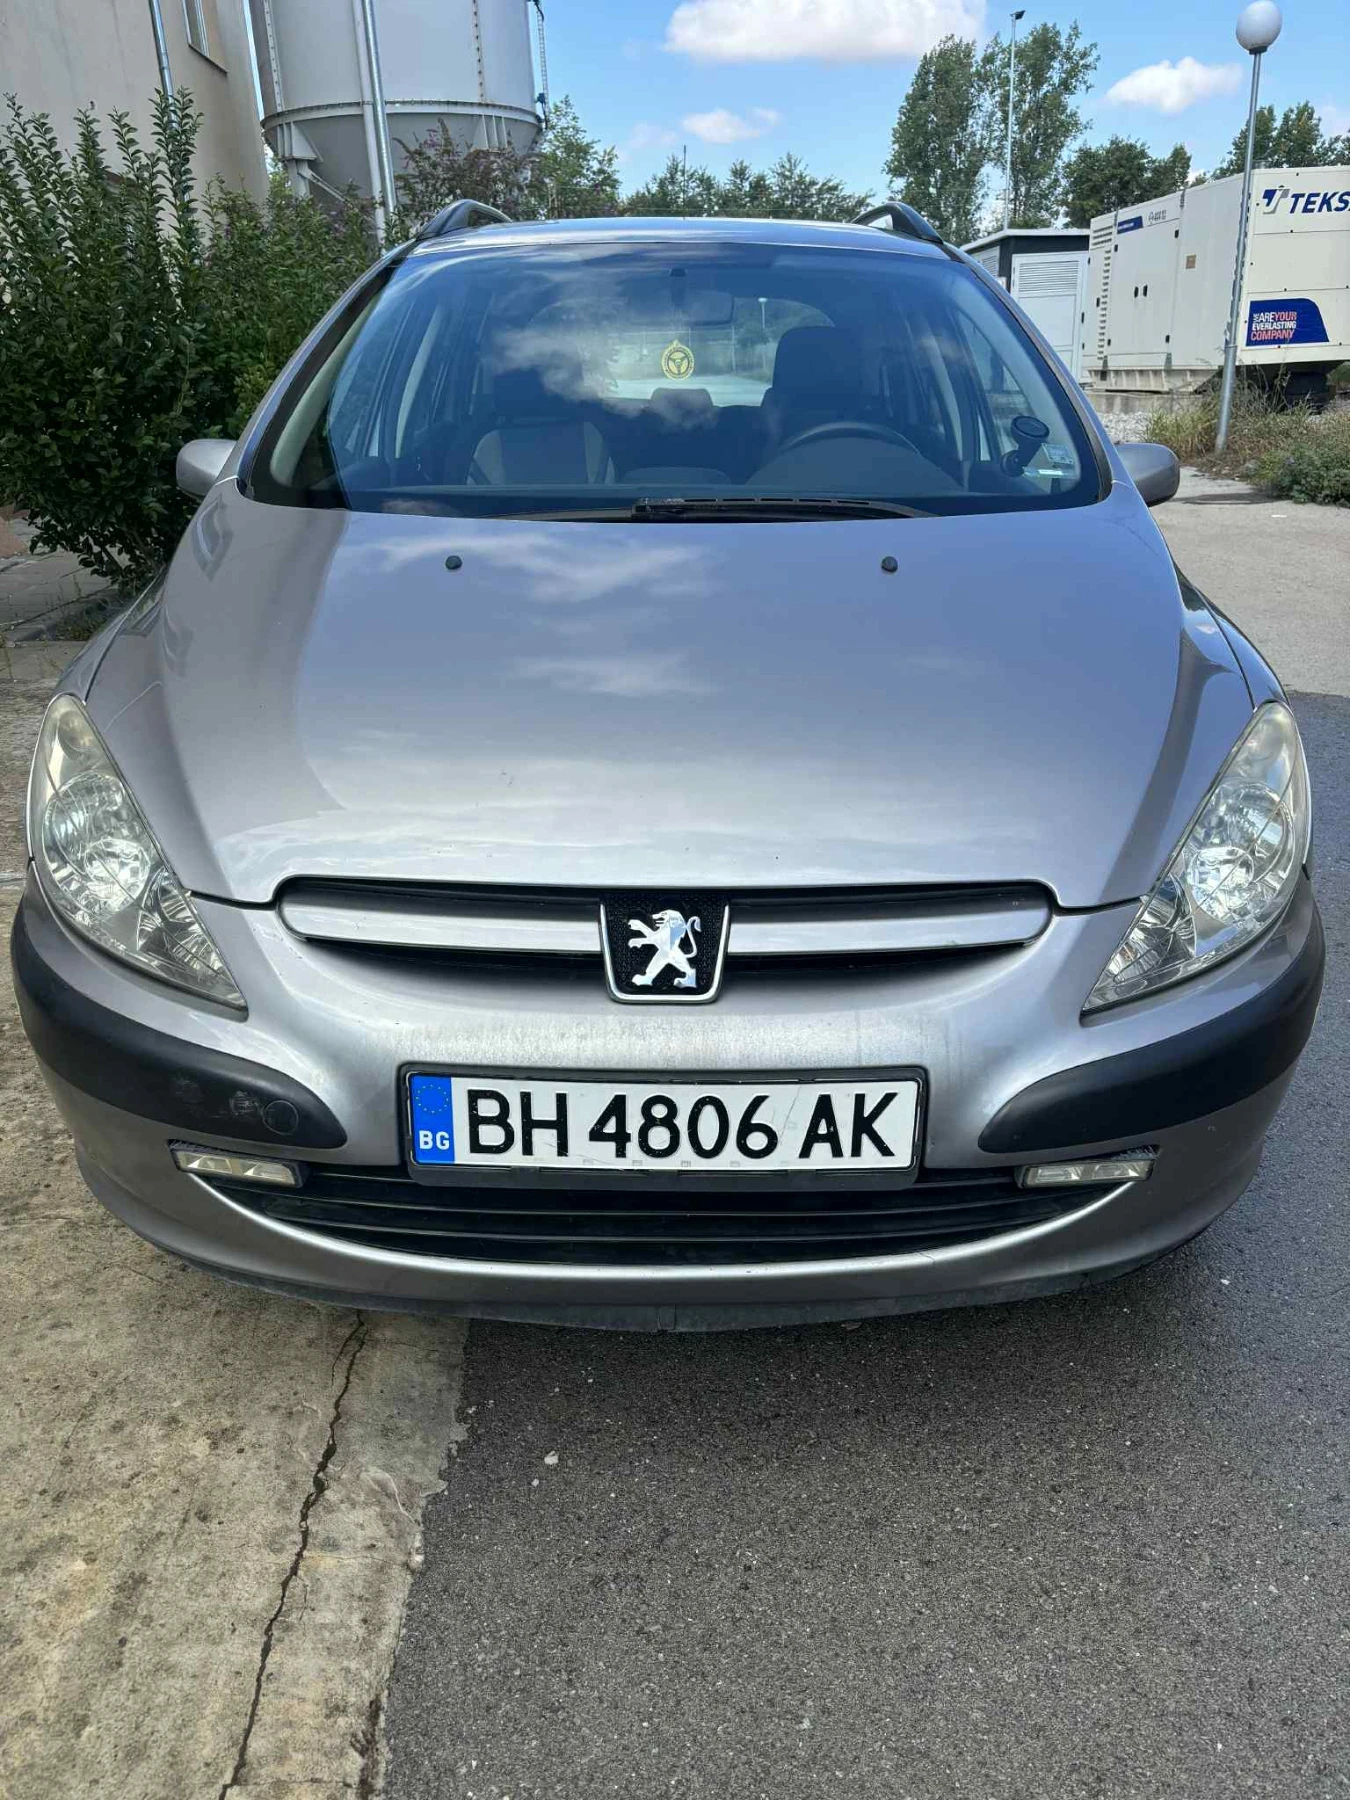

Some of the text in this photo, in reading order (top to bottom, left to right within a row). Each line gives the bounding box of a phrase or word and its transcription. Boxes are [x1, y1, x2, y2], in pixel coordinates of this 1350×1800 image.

[1290, 191, 1350, 214] TEKS
[1251, 330, 1295, 341] COMPANY
[1252, 321, 1297, 330] EVERLASTING
[467, 1089, 899, 1159] BH 4806 AK
[419, 1131, 450, 1151] BG
